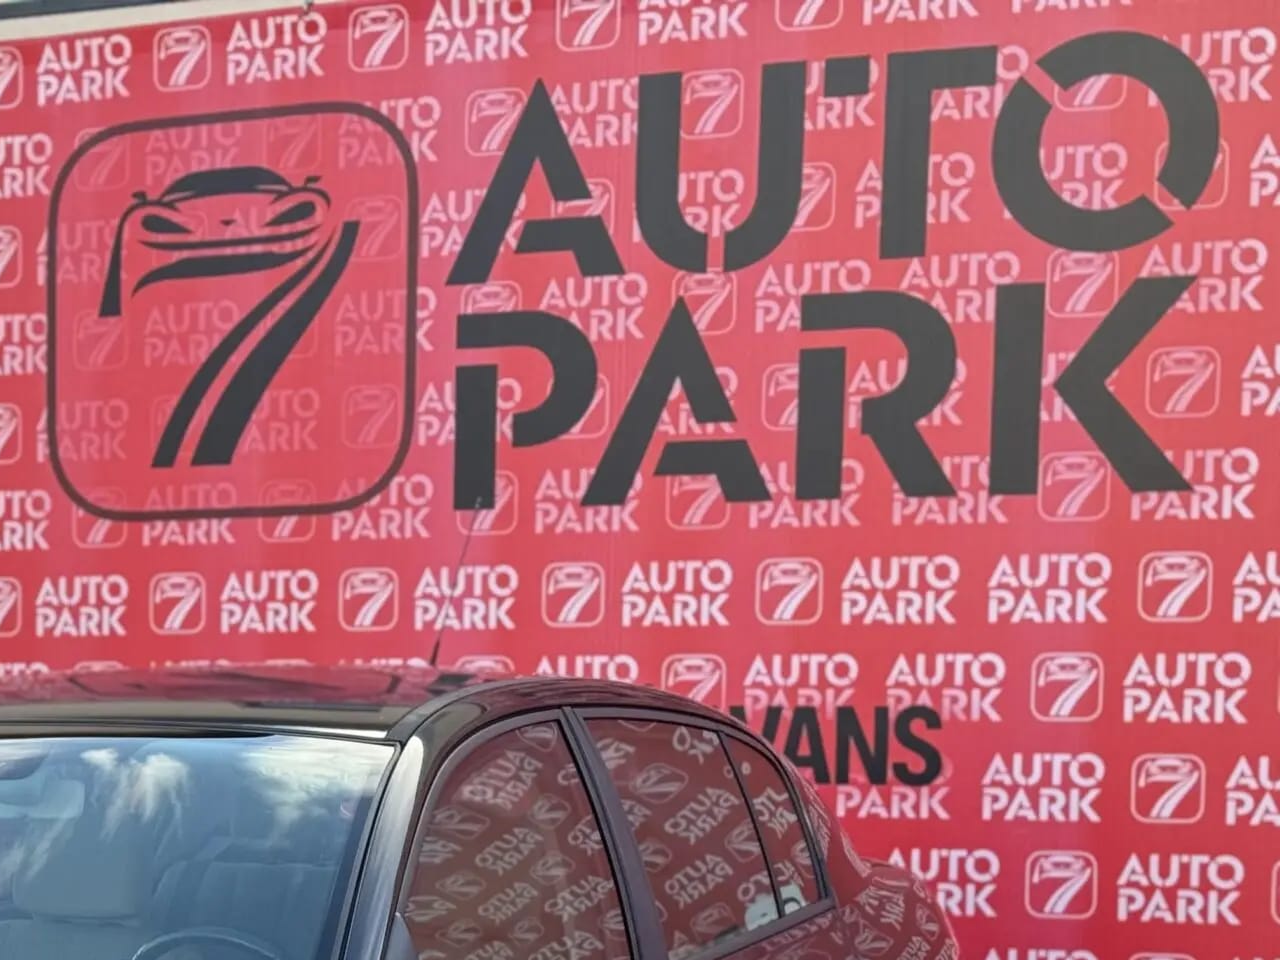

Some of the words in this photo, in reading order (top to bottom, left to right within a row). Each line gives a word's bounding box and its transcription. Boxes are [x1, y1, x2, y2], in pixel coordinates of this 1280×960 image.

[227, 11, 328, 52] AUTO
[638, 9, 747, 45] PARK
[37, 35, 132, 74] AUTO
[425, 26, 528, 66] PARK
[227, 45, 325, 86] PARK
[37, 68, 130, 106] PARK
[446, 30, 1221, 286] AUTO
[899, 253, 1020, 290] AUTO
[1138, 239, 1267, 278] AUTO
[542, 271, 647, 309] AUTO
[756, 260, 871, 296] AUTO
[454, 275, 1198, 511] PARK
[535, 498, 639, 534] PARK
[748, 495, 860, 528] PARK
[892, 490, 1008, 526] PARK
[1131, 484, 1255, 520] PARK
[142, 518, 236, 546] PARK
[331, 508, 431, 540] PARK
[220, 569, 319, 602] AUTO
[414, 564, 518, 599] AUTO
[622, 559, 732, 593] AUTO
[841, 555, 960, 590] AUTO
[988, 552, 1112, 588] AUTO
[35, 575, 128, 607] AUTO
[841, 590, 956, 625] PARK
[988, 588, 1108, 623] PARK
[36, 605, 126, 637] PARK
[221, 600, 316, 633] PARK
[414, 596, 515, 631] PARK
[622, 593, 729, 627] PARK
[744, 653, 858, 686] AUTO
[886, 652, 1006, 687] AUTO
[1123, 652, 1252, 687] AUTO
[1123, 687, 1247, 724] PARK
[982, 752, 1105, 787] AUTO
[836, 784, 950, 820] PARK
[982, 785, 1101, 823] PARK
[1117, 853, 1244, 891] AUTO
[1117, 886, 1240, 925] PARK
